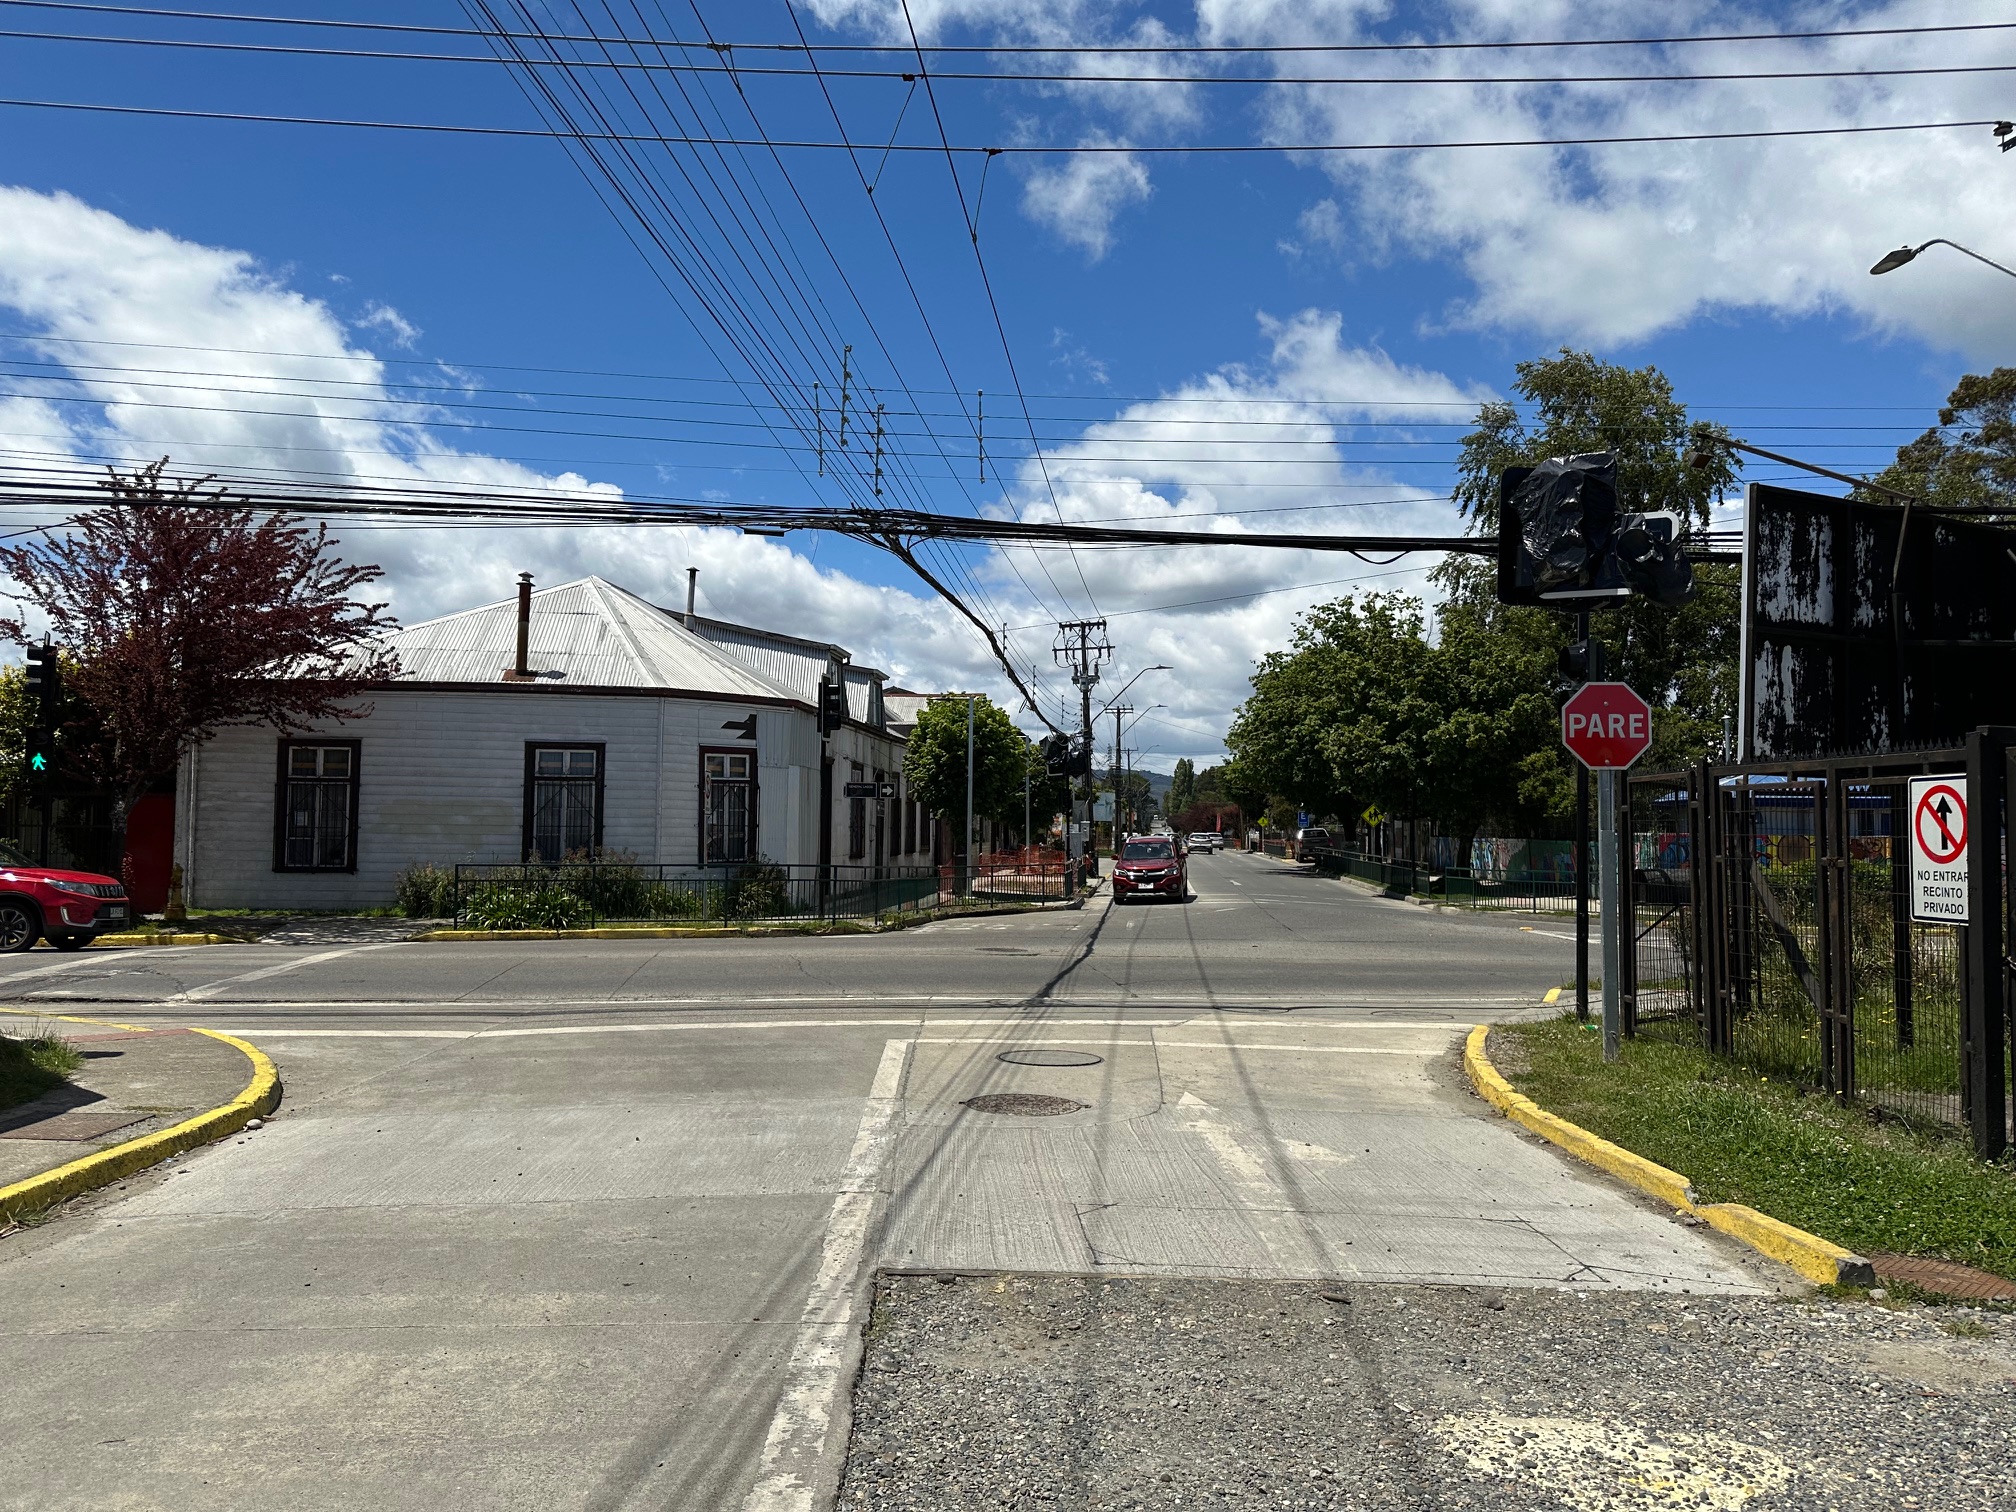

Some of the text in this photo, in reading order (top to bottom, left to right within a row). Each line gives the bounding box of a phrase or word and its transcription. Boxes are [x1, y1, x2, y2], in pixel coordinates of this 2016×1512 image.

[1568, 713, 1645, 739] PARE
[1300, 812, 1306, 820] E
[1917, 870, 1931, 881] NO
[1923, 886, 1963, 899] RECINTO
[1923, 901, 1964, 915] PRIVADO
